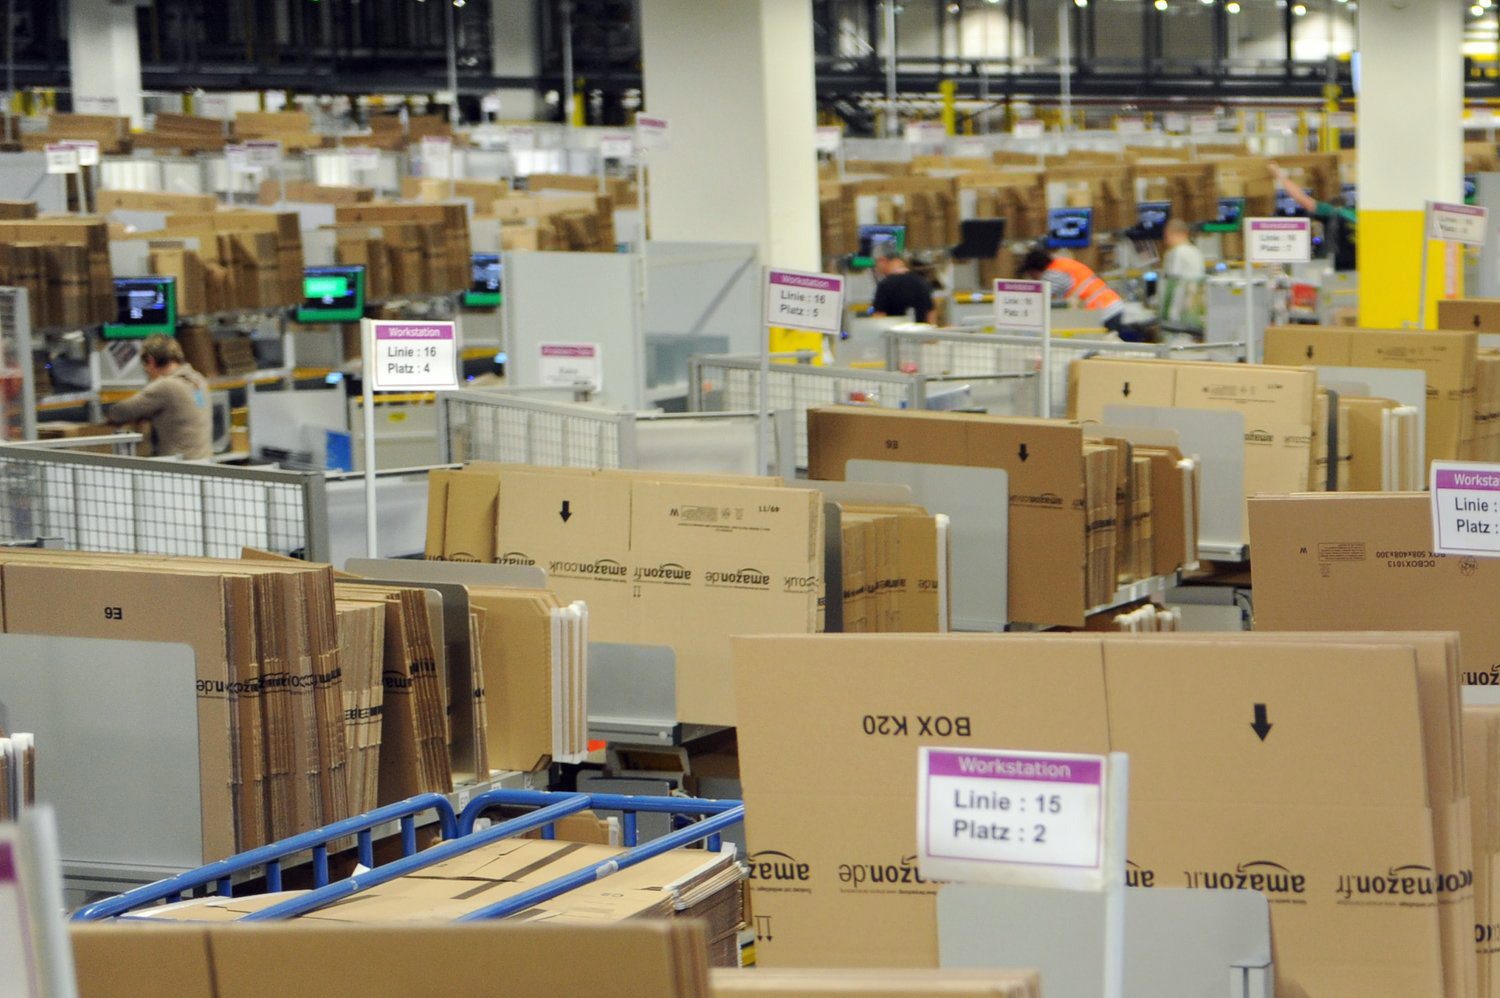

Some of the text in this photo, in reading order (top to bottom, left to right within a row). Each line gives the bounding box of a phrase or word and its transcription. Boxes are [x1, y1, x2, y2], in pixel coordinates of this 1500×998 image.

[781, 290, 806, 302] Linie
[781, 304, 805, 317] Platz
[389, 326, 440, 337] Workstation
[388, 346, 414, 358] Linie
[424, 346, 437, 358] 16
[388, 362, 414, 375] Platz
[423, 362, 431, 374] 4
[1455, 496, 1490, 513] Linie
[1456, 518, 1491, 534] Platz
[103, 606, 123, 620] E6
[863, 715, 972, 737] BOX K20
[958, 756, 1071, 778] Workstation
[953, 789, 1011, 811] Linie
[1035, 794, 1062, 815] 15
[953, 818, 1010, 842] Platz
[1033, 823, 1047, 843] 2
